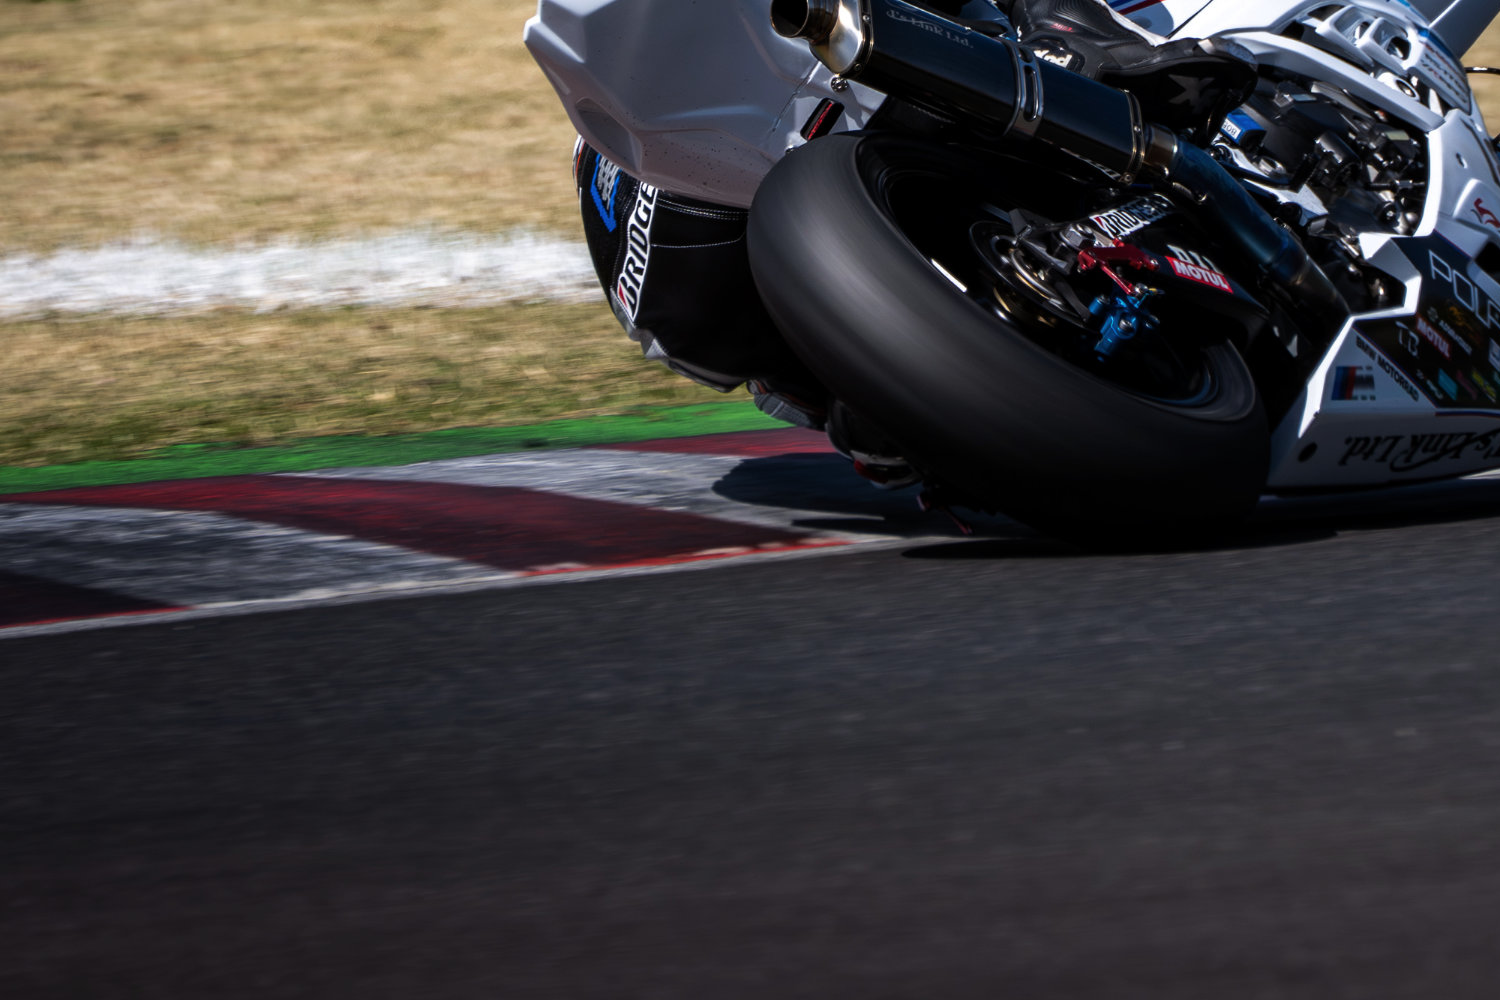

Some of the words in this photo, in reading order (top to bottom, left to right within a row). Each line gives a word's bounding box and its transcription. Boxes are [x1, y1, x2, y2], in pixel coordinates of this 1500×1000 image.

[945, 31, 975, 49] Ltd.
[1172, 259, 1230, 291] MOTUL
[1417, 317, 1451, 359] MOTUL
[1377, 354, 1419, 402] MOTORRAD
[1338, 434, 1404, 467] Ltd.
